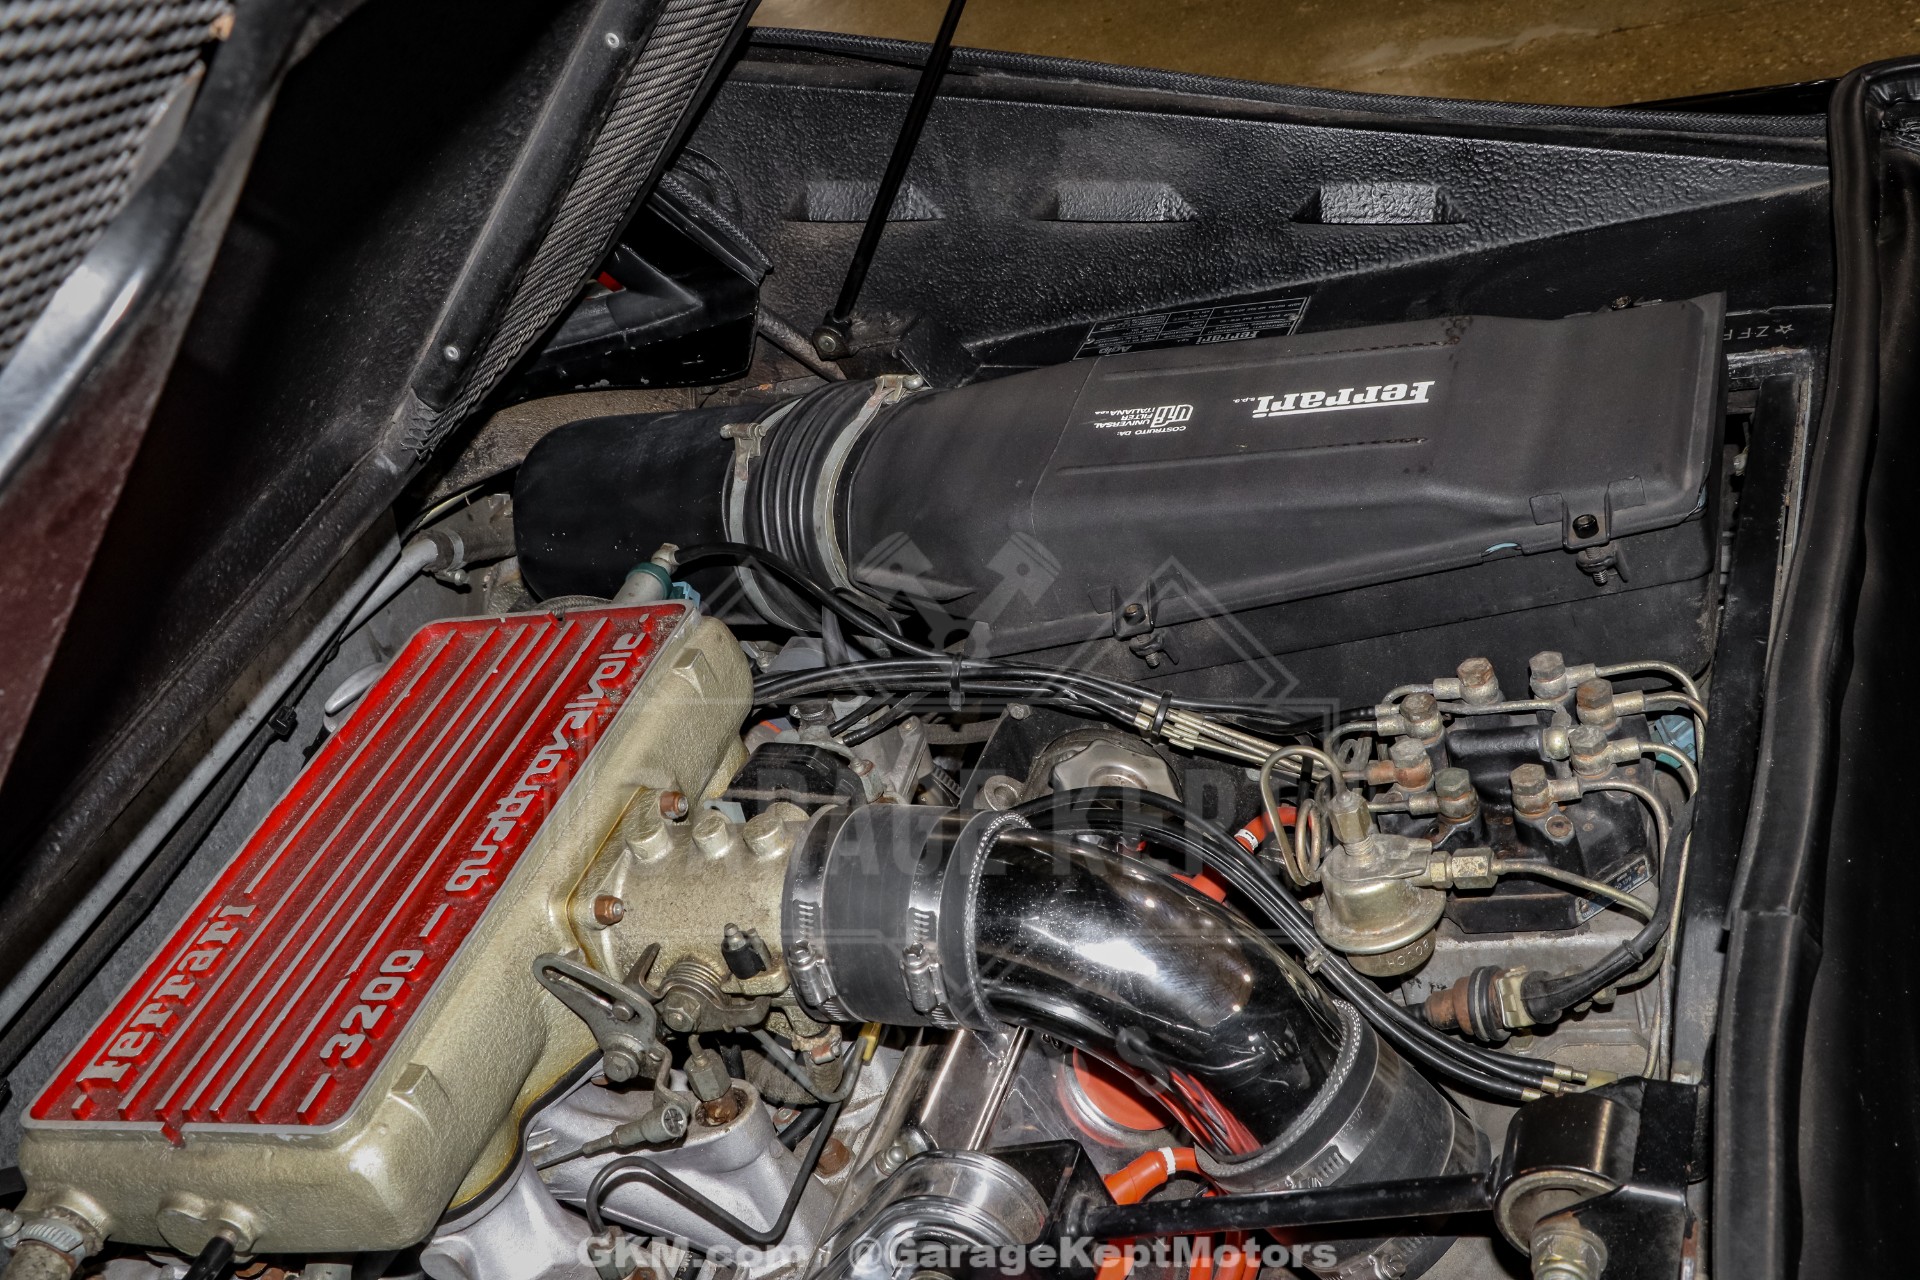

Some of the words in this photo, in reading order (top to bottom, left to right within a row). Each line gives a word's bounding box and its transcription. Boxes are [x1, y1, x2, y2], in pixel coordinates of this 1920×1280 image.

[1109, 406, 1156, 416] ITALIANA
[1251, 380, 1436, 419] Ferrari
[1093, 419, 1151, 429] UNIVERSAL
[1120, 412, 1154, 421] FILTER
[1134, 425, 1187, 436] COSTRUITO
[444, 631, 648, 893] quattrovalvole
[75, 902, 258, 1087] Ferrari
[319, 948, 425, 1063] 3200
